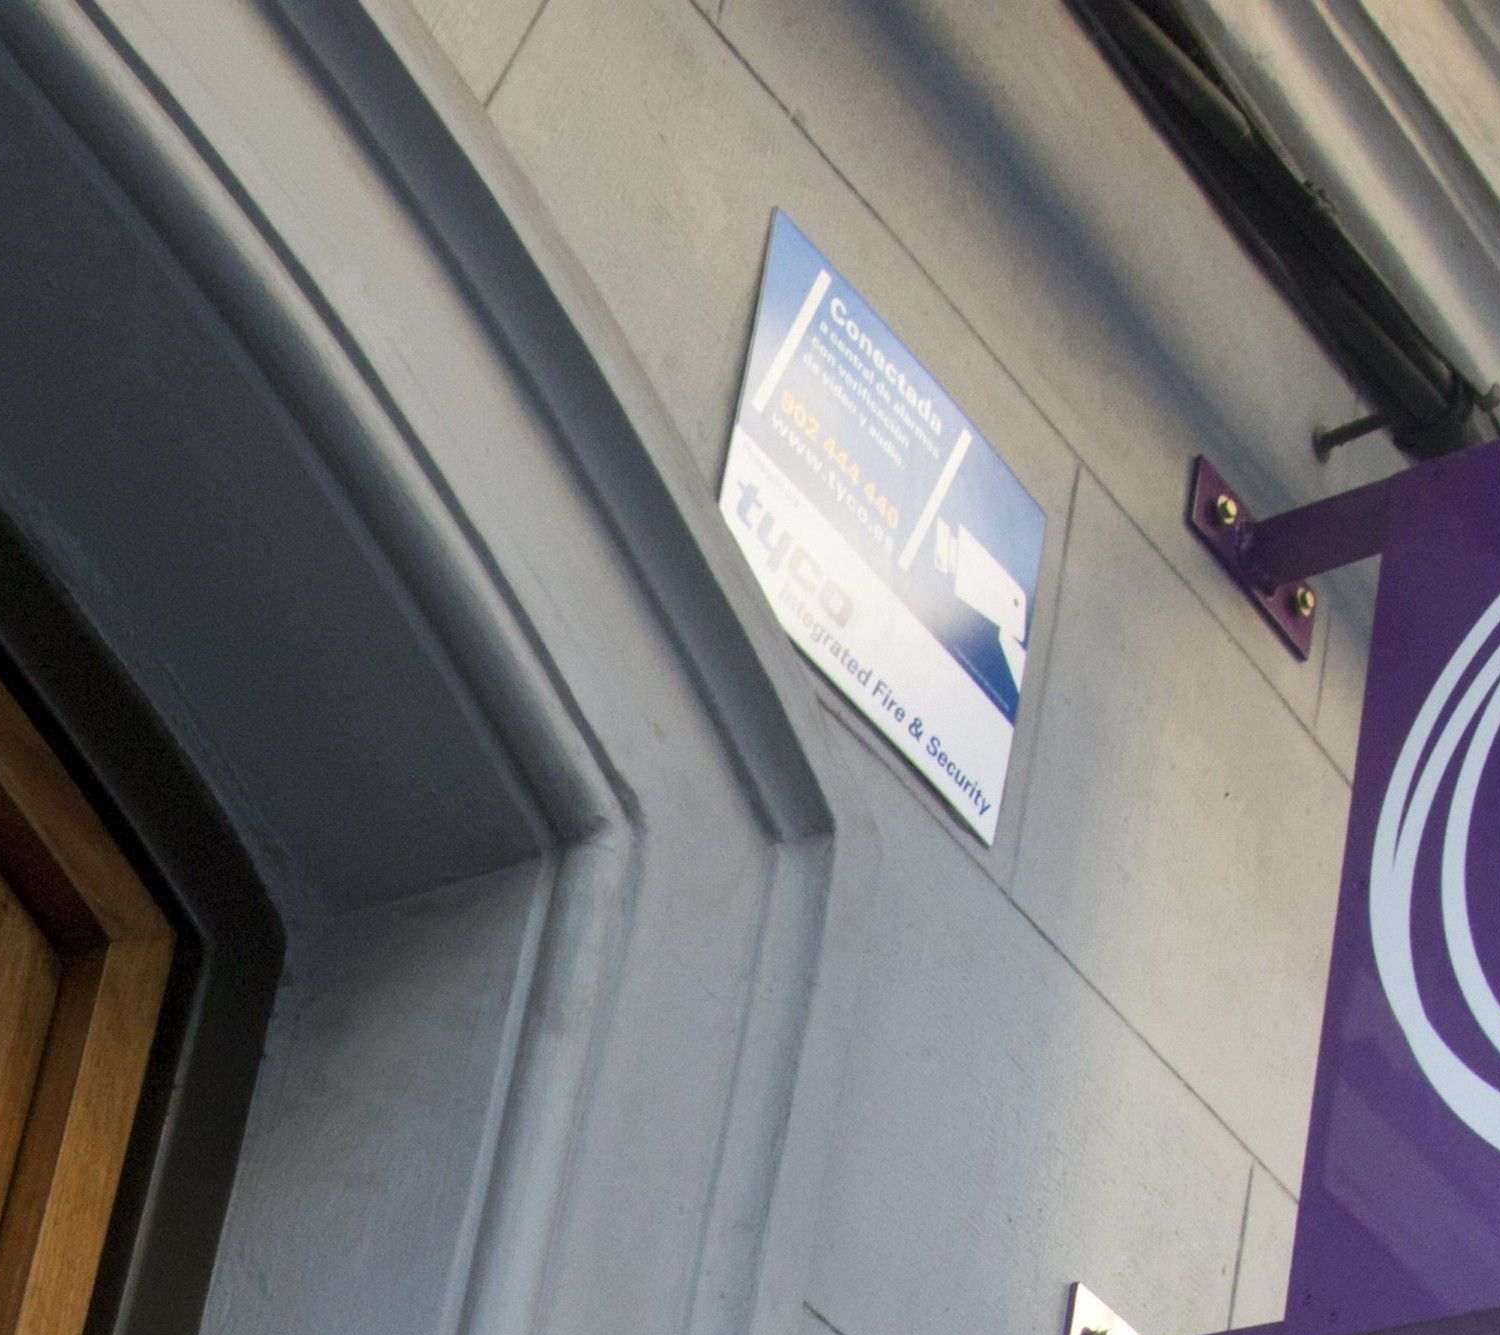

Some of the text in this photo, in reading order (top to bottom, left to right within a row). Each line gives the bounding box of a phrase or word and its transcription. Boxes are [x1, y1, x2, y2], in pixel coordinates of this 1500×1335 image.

[830, 297, 942, 435] Conectada
[871, 678, 907, 722] Fire
[908, 716, 925, 741] &
[926, 735, 992, 816] Security
